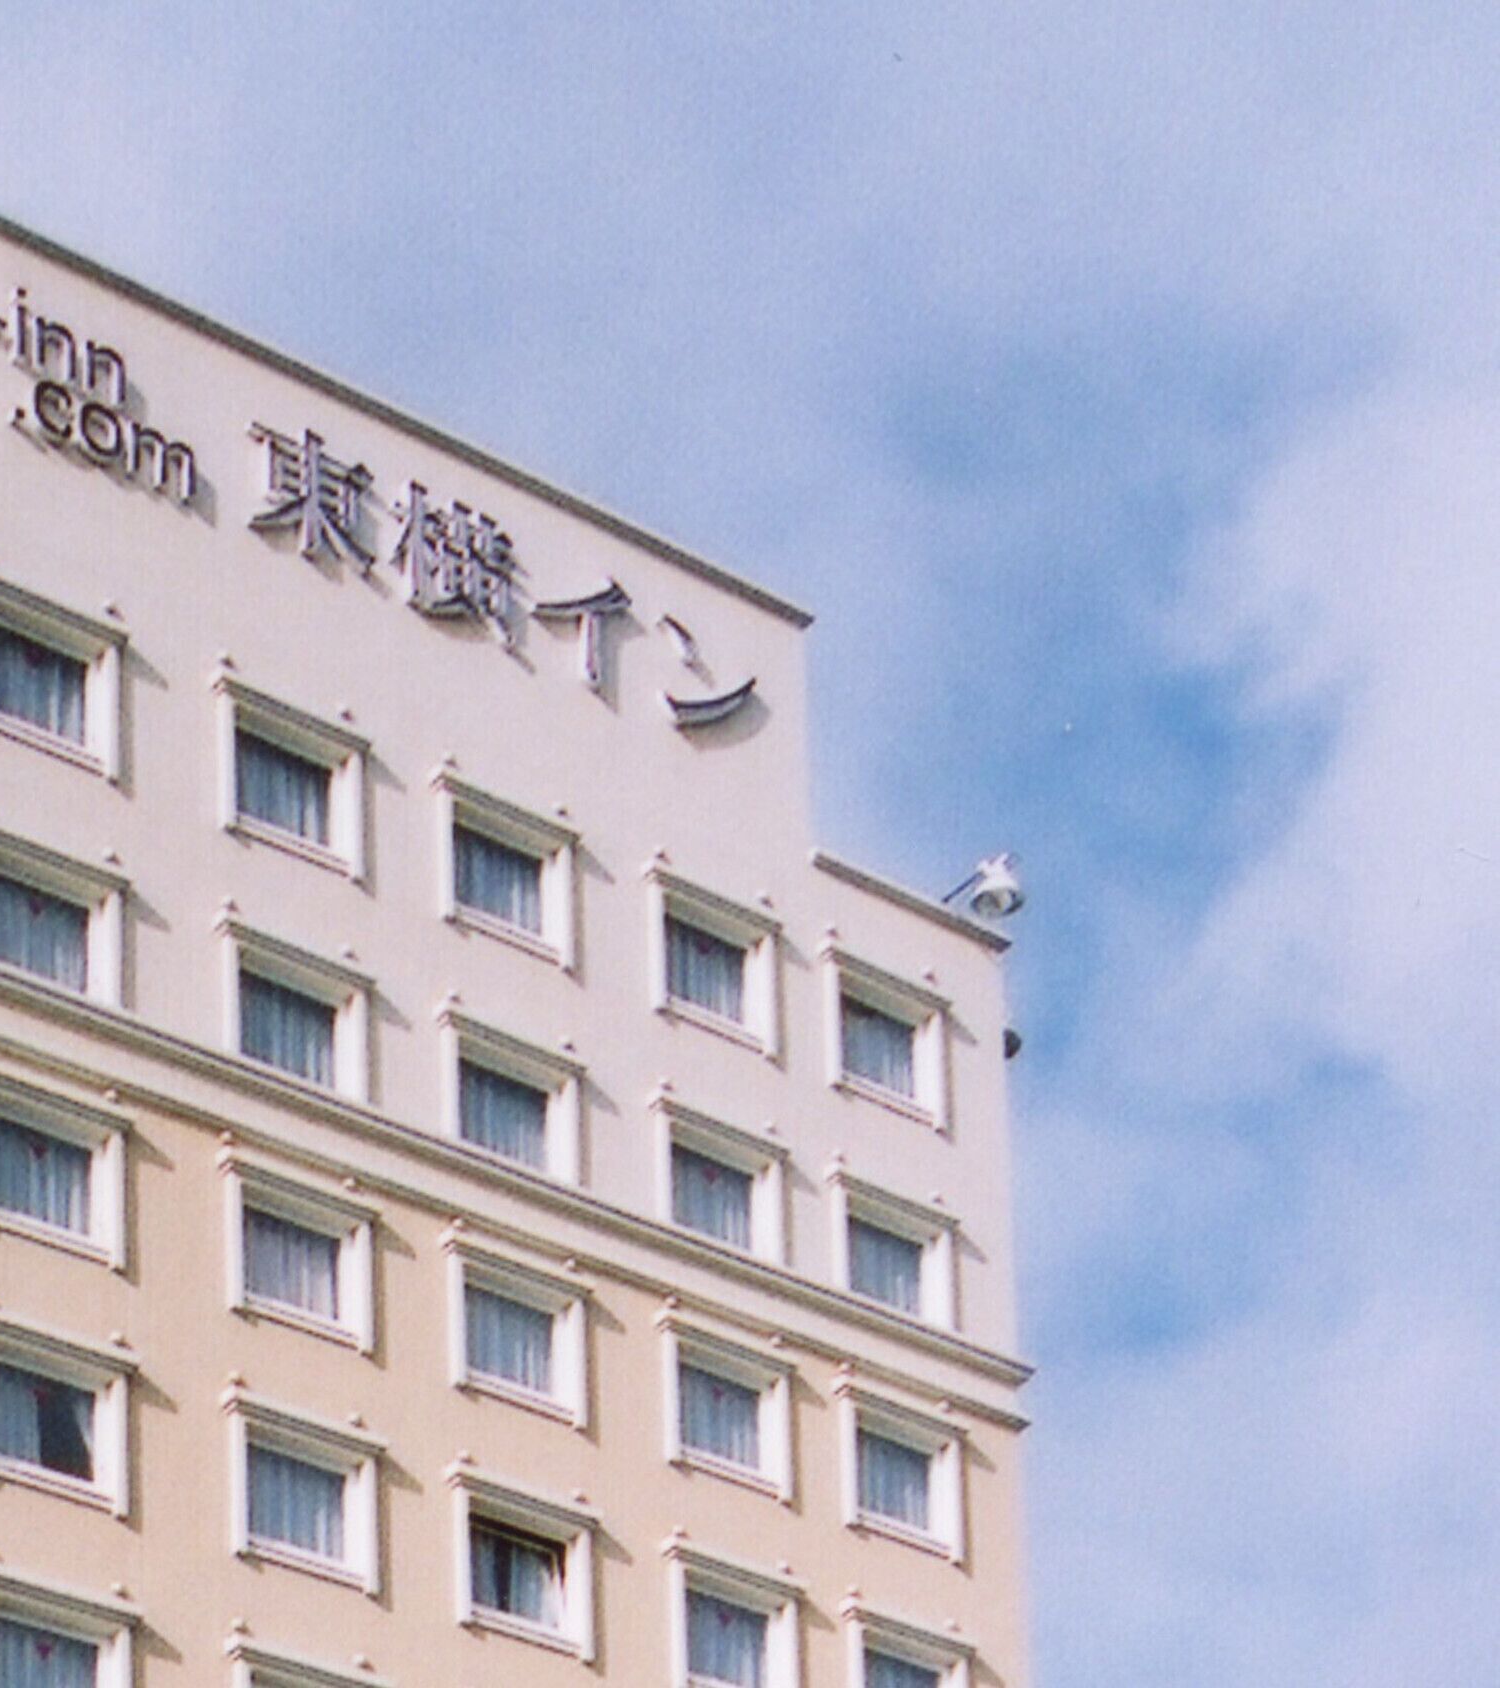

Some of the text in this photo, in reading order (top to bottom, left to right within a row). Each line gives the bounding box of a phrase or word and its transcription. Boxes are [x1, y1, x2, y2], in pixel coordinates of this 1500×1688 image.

[10, 379, 199, 505] .com
[246, 421, 757, 729] 東横イン
